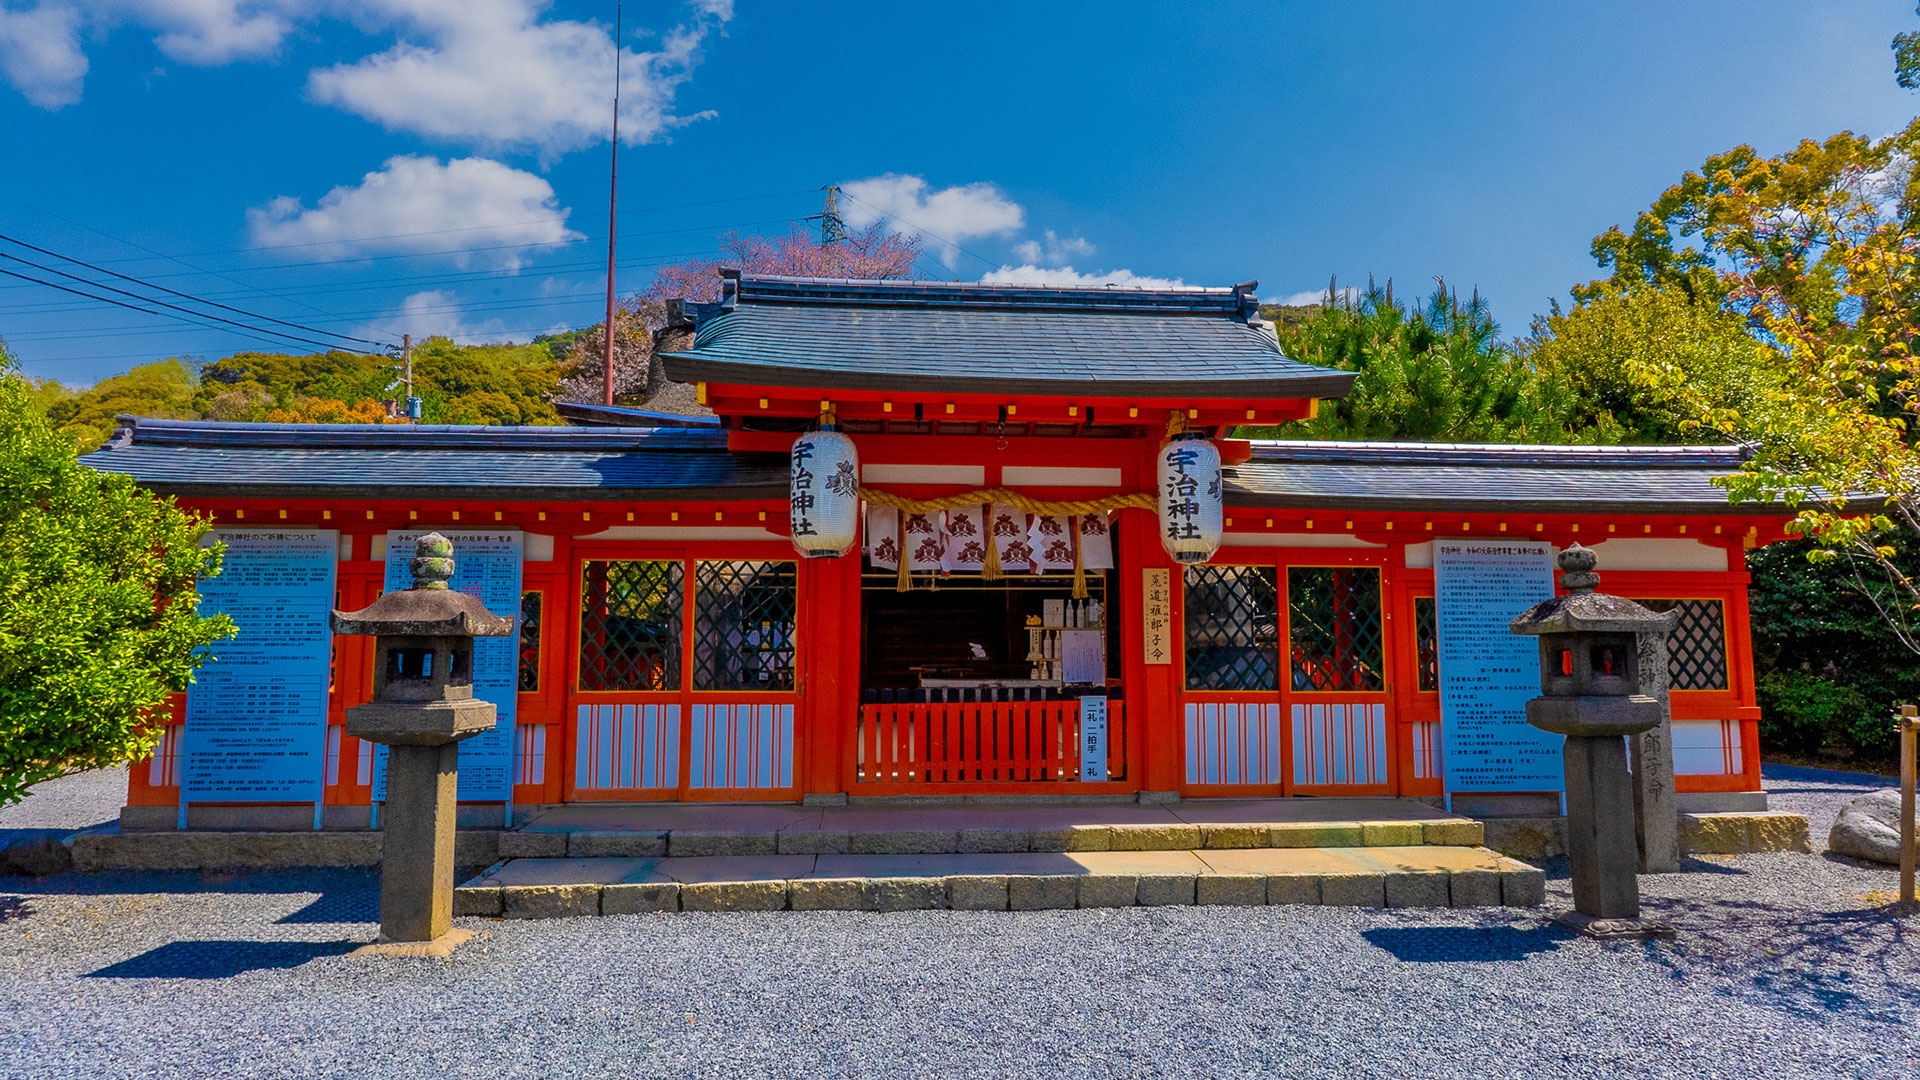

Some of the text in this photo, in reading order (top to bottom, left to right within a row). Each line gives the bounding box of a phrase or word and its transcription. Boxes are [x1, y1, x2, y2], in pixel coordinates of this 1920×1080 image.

[791, 440, 818, 537] 宇治神社
[1166, 447, 1202, 540] 宇治神社
[218, 533, 317, 541] 宇治神社のご祈祷について
[443, 535, 513, 543] 神社の厄年等一覧表
[1087, 703, 1098, 777] 二礼 二拍手 一礼
